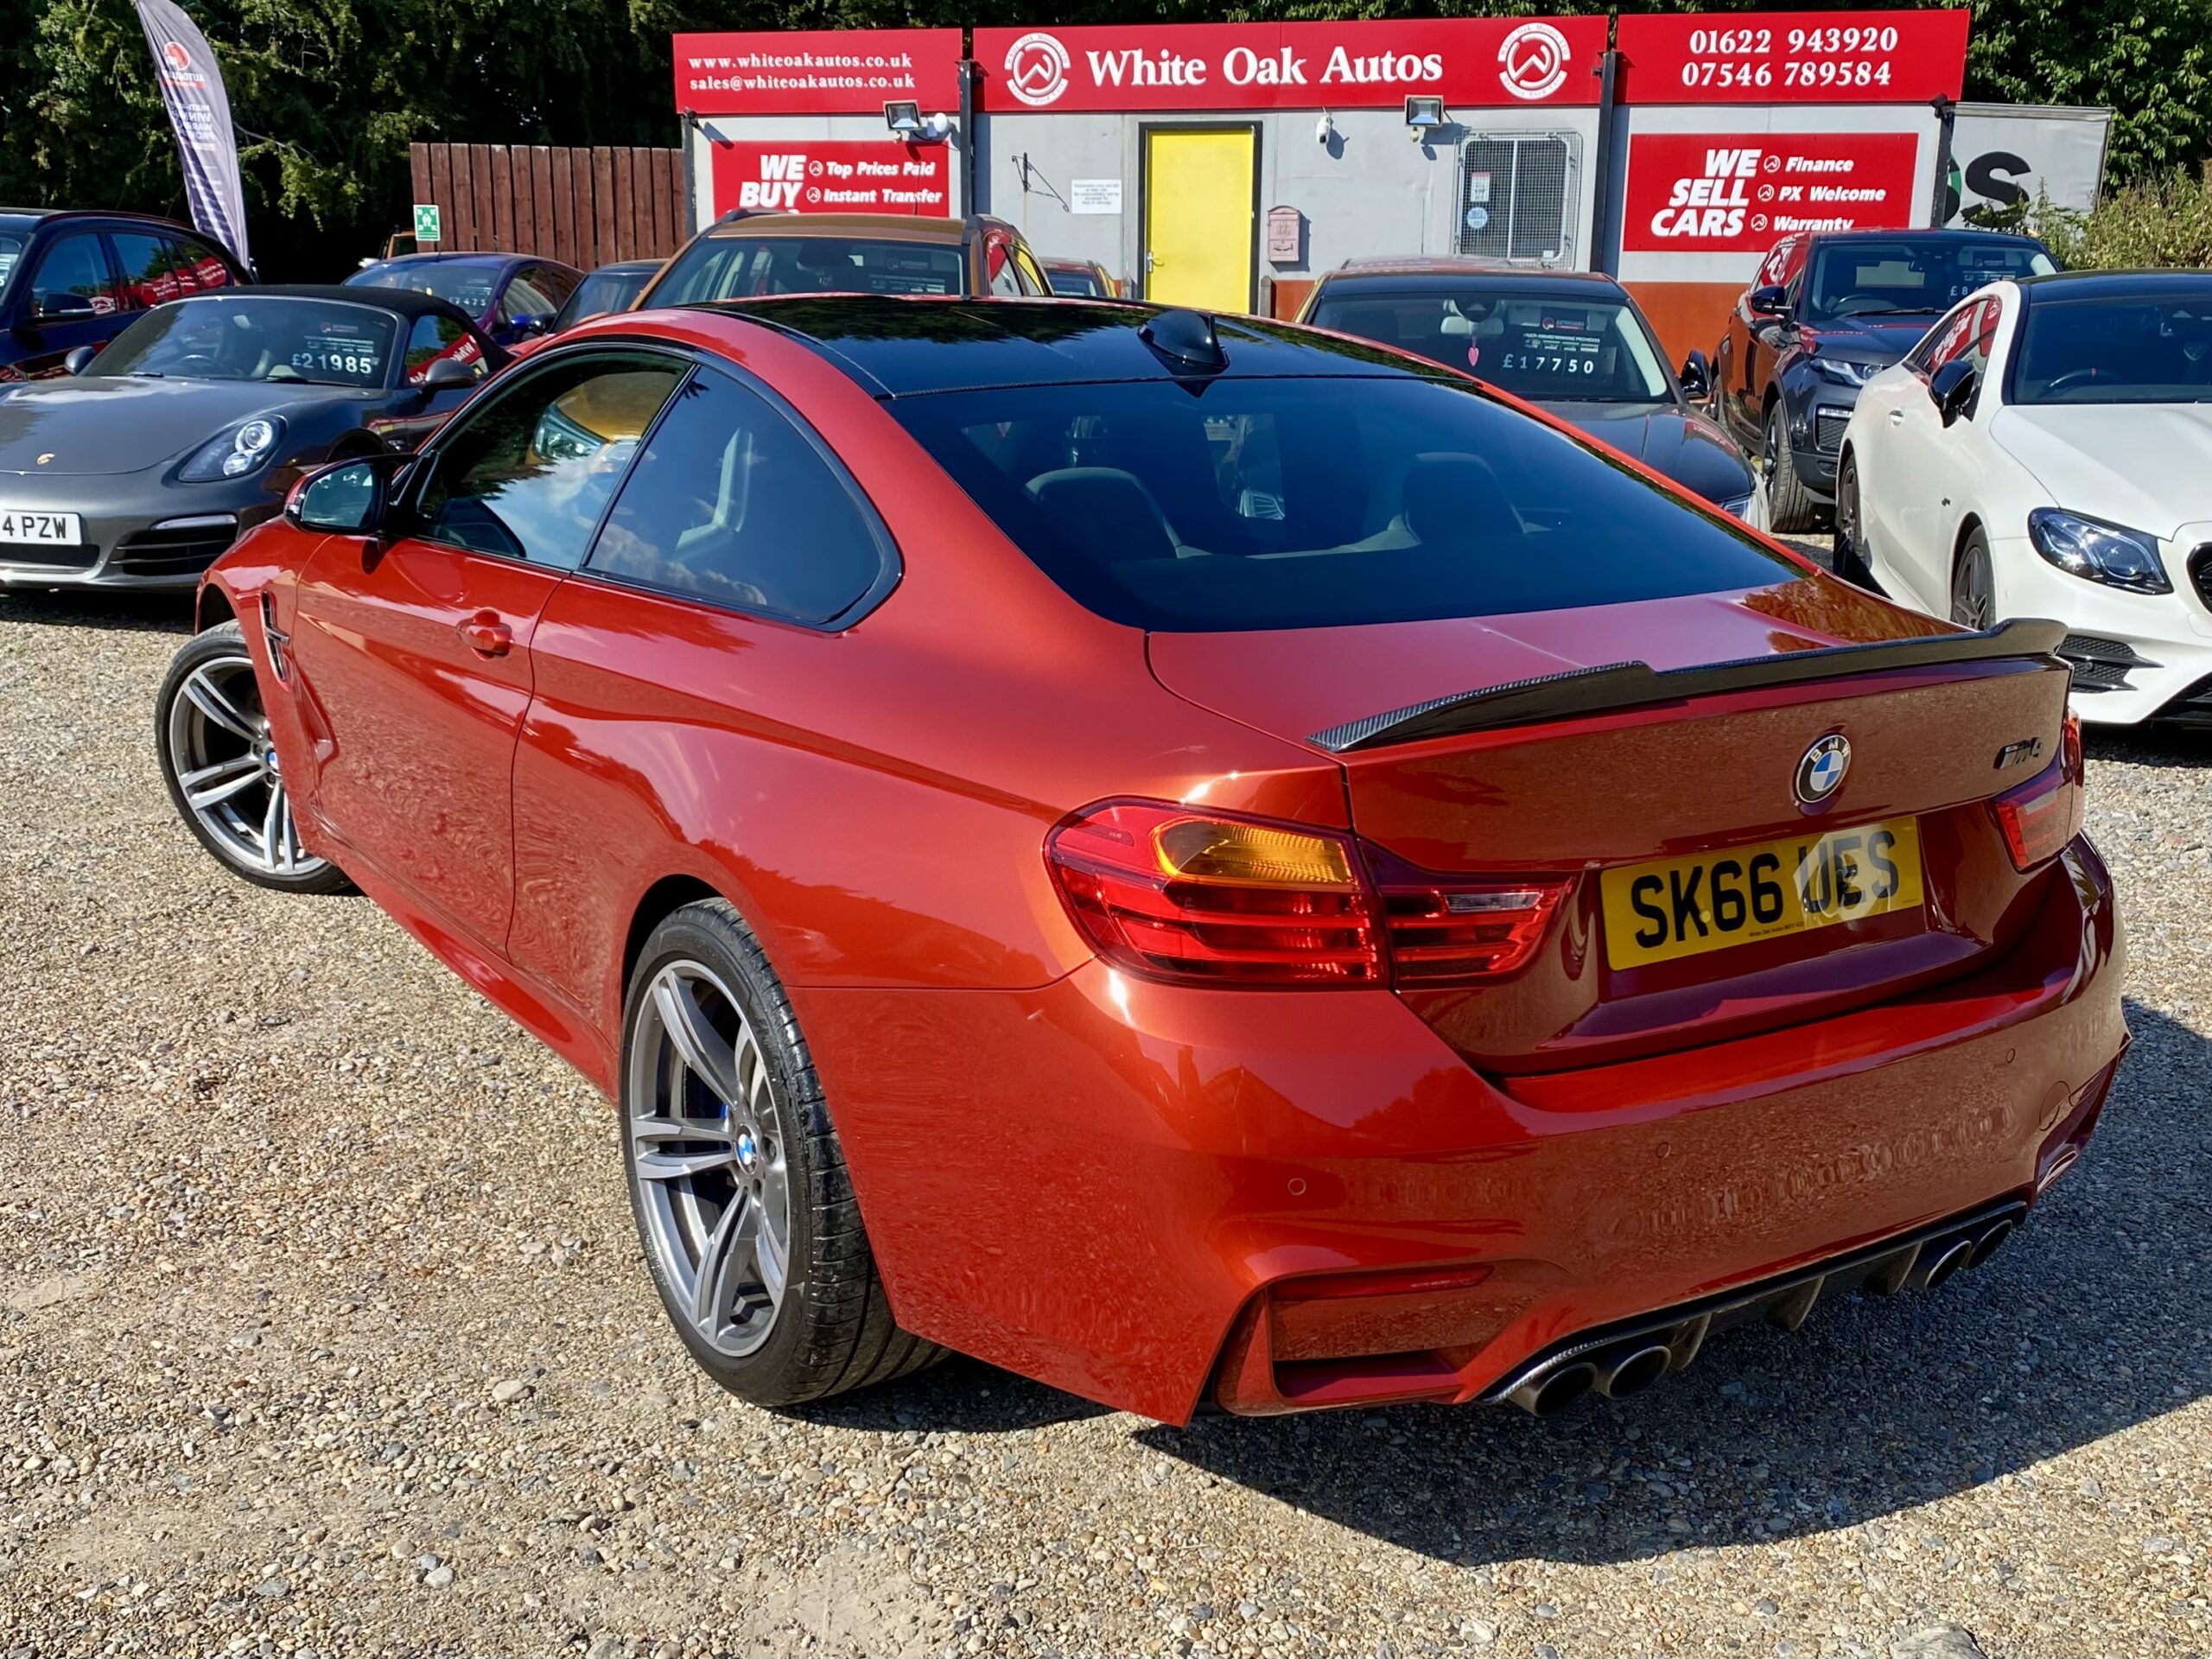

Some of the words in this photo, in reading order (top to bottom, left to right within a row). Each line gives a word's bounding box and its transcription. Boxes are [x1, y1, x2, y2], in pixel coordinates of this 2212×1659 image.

[1689, 29, 1771, 54] 01622
[1788, 27, 1898, 54] 943920
[688, 52, 912, 68] www.whiteoakautos.co.uk
[1085, 48, 1206, 86] White
[1223, 46, 1308, 86] Oak
[1319, 45, 1443, 84] Autos
[690, 73, 915, 91] sales@whiteoakautos.co.uk
[1681, 61, 1772, 87] 07546
[1783, 60, 1891, 86] 789584
[760, 155, 807, 181] WE
[826, 162, 854, 179] Top
[856, 162, 899, 176] Prices
[902, 162, 936, 175] Paid
[1705, 149, 1763, 177] WE
[1785, 156, 1854, 172] Finance
[739, 181, 804, 207] BUY
[823, 188, 877, 203] Instant
[881, 188, 943, 203] Transfer
[1669, 178, 1750, 207] SELL
[1778, 186, 1804, 201] PX
[1809, 186, 1887, 201] Welcome
[1650, 208, 1746, 237] CARS
[292, 353, 372, 374] £21985
[1503, 353, 1594, 374] £17750
[22, 516, 66, 539] PZW
[1630, 852, 1784, 949] SK66
